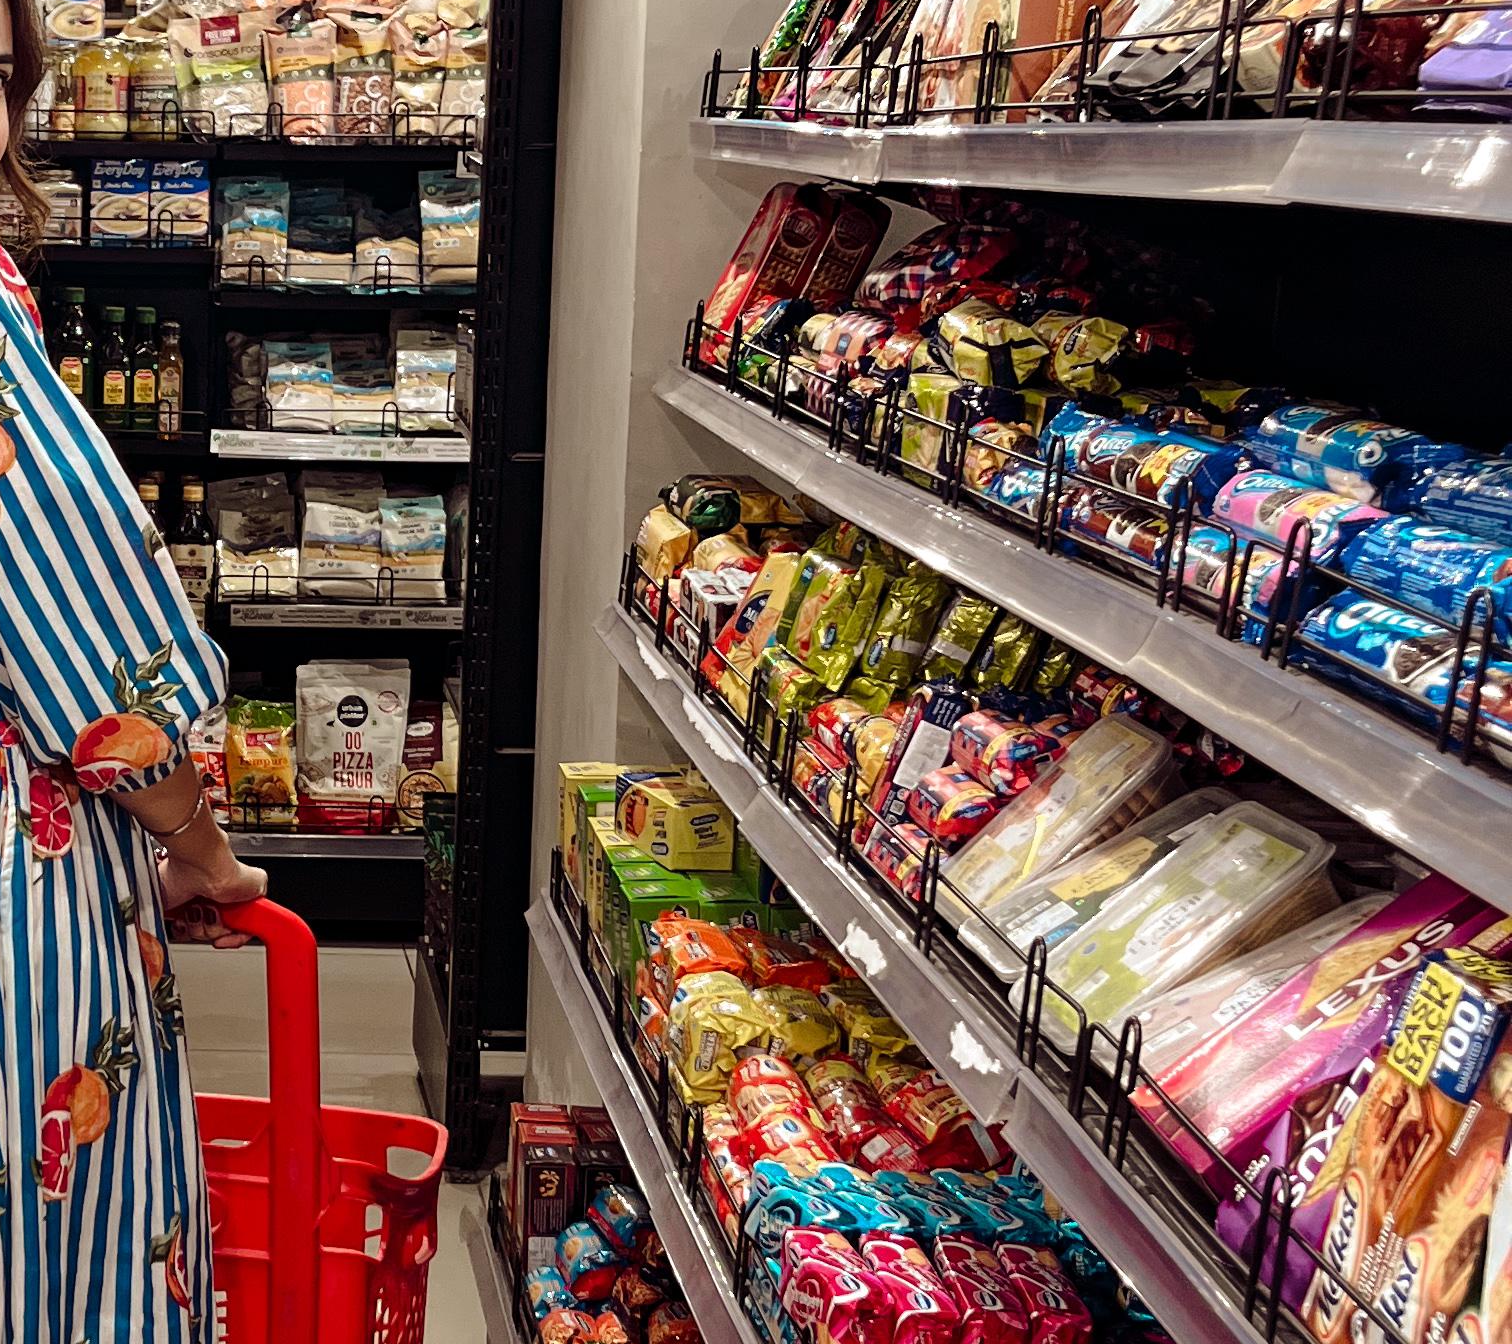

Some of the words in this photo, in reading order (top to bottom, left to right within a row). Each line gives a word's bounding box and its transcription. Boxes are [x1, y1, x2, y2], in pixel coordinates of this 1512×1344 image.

[94, 162, 146, 179] EveryDay
[151, 162, 204, 179] EveryDay
[333, 752, 373, 770] PIZZA
[333, 771, 373, 789] FLOUR
[1283, 919, 1455, 1040] LEXUS
[1393, 974, 1441, 1065] CASH
[1408, 987, 1454, 1076] BACK
[1277, 1057, 1376, 1208] LEXUS
